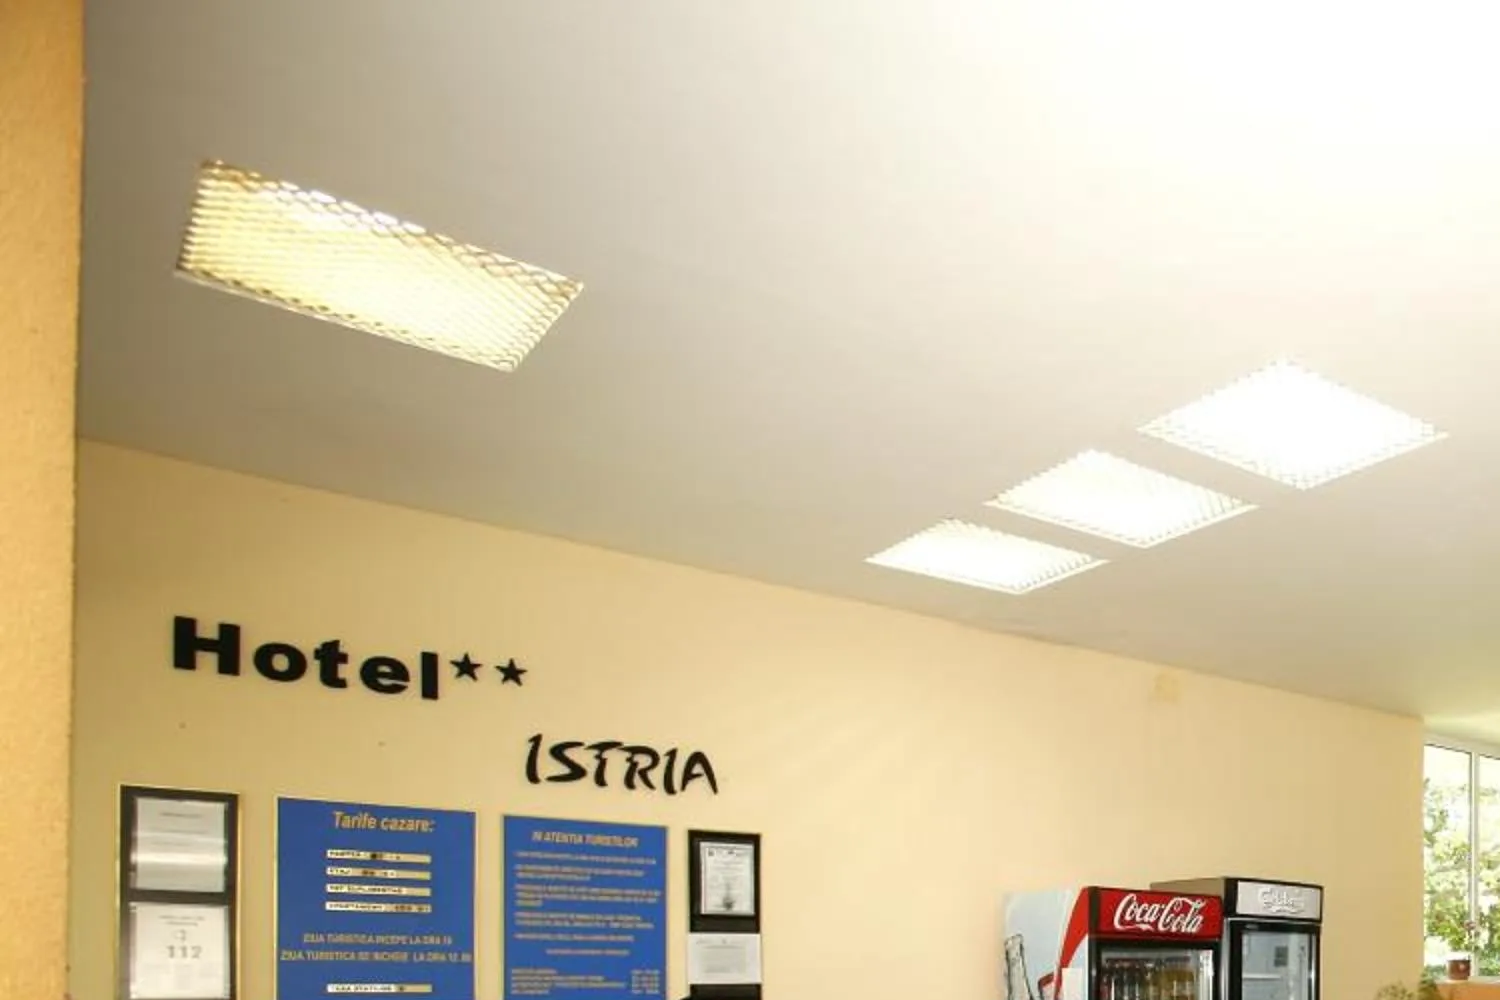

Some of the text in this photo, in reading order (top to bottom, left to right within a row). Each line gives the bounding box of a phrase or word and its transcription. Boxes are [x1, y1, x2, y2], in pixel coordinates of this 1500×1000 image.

[172, 615, 439, 700] Hotel
[524, 733, 719, 796] ISTRIA
[333, 811, 436, 833] Tarife cazare:
[1113, 893, 1206, 933] Coca-Cola
[166, 945, 203, 959] 112
